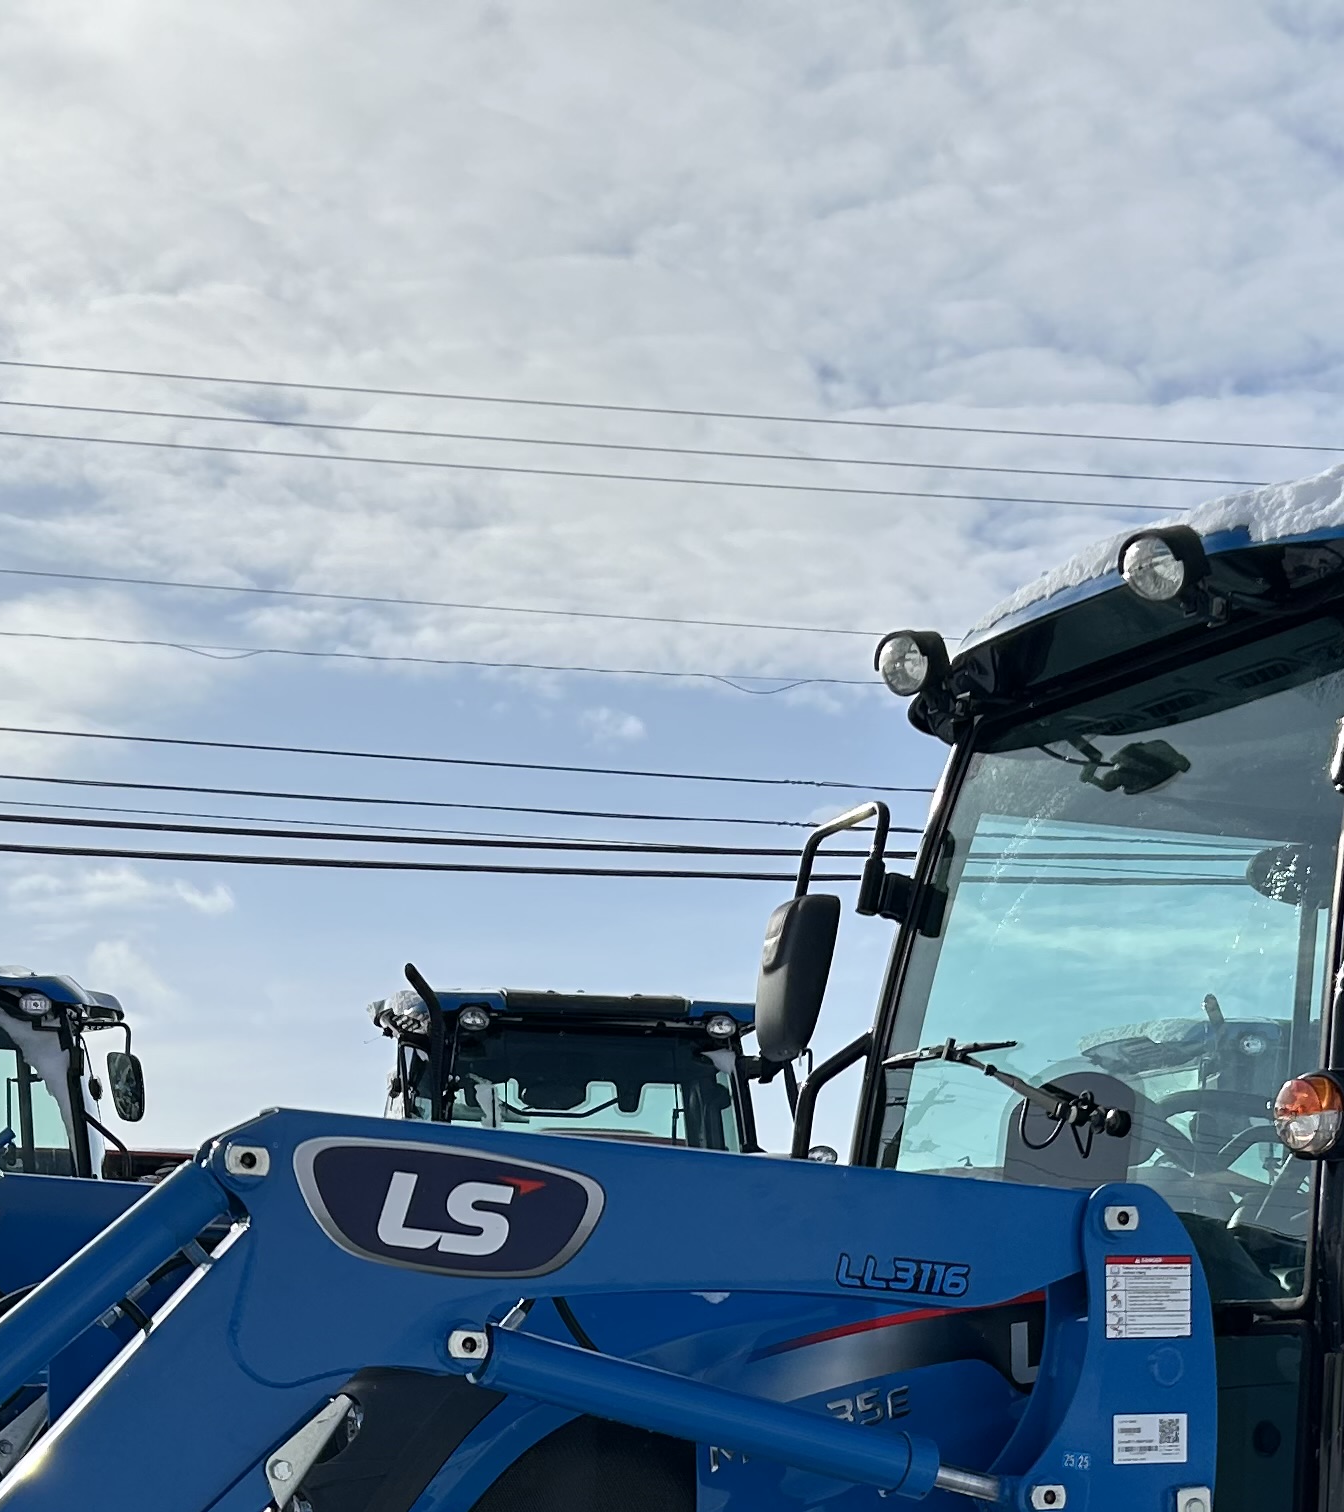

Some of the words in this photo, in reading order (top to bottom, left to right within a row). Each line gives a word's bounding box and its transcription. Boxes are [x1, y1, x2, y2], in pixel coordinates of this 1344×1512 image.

[377, 1171, 514, 1256] LS
[836, 1253, 971, 1297] LL3116
[1011, 1321, 1041, 1384] L
